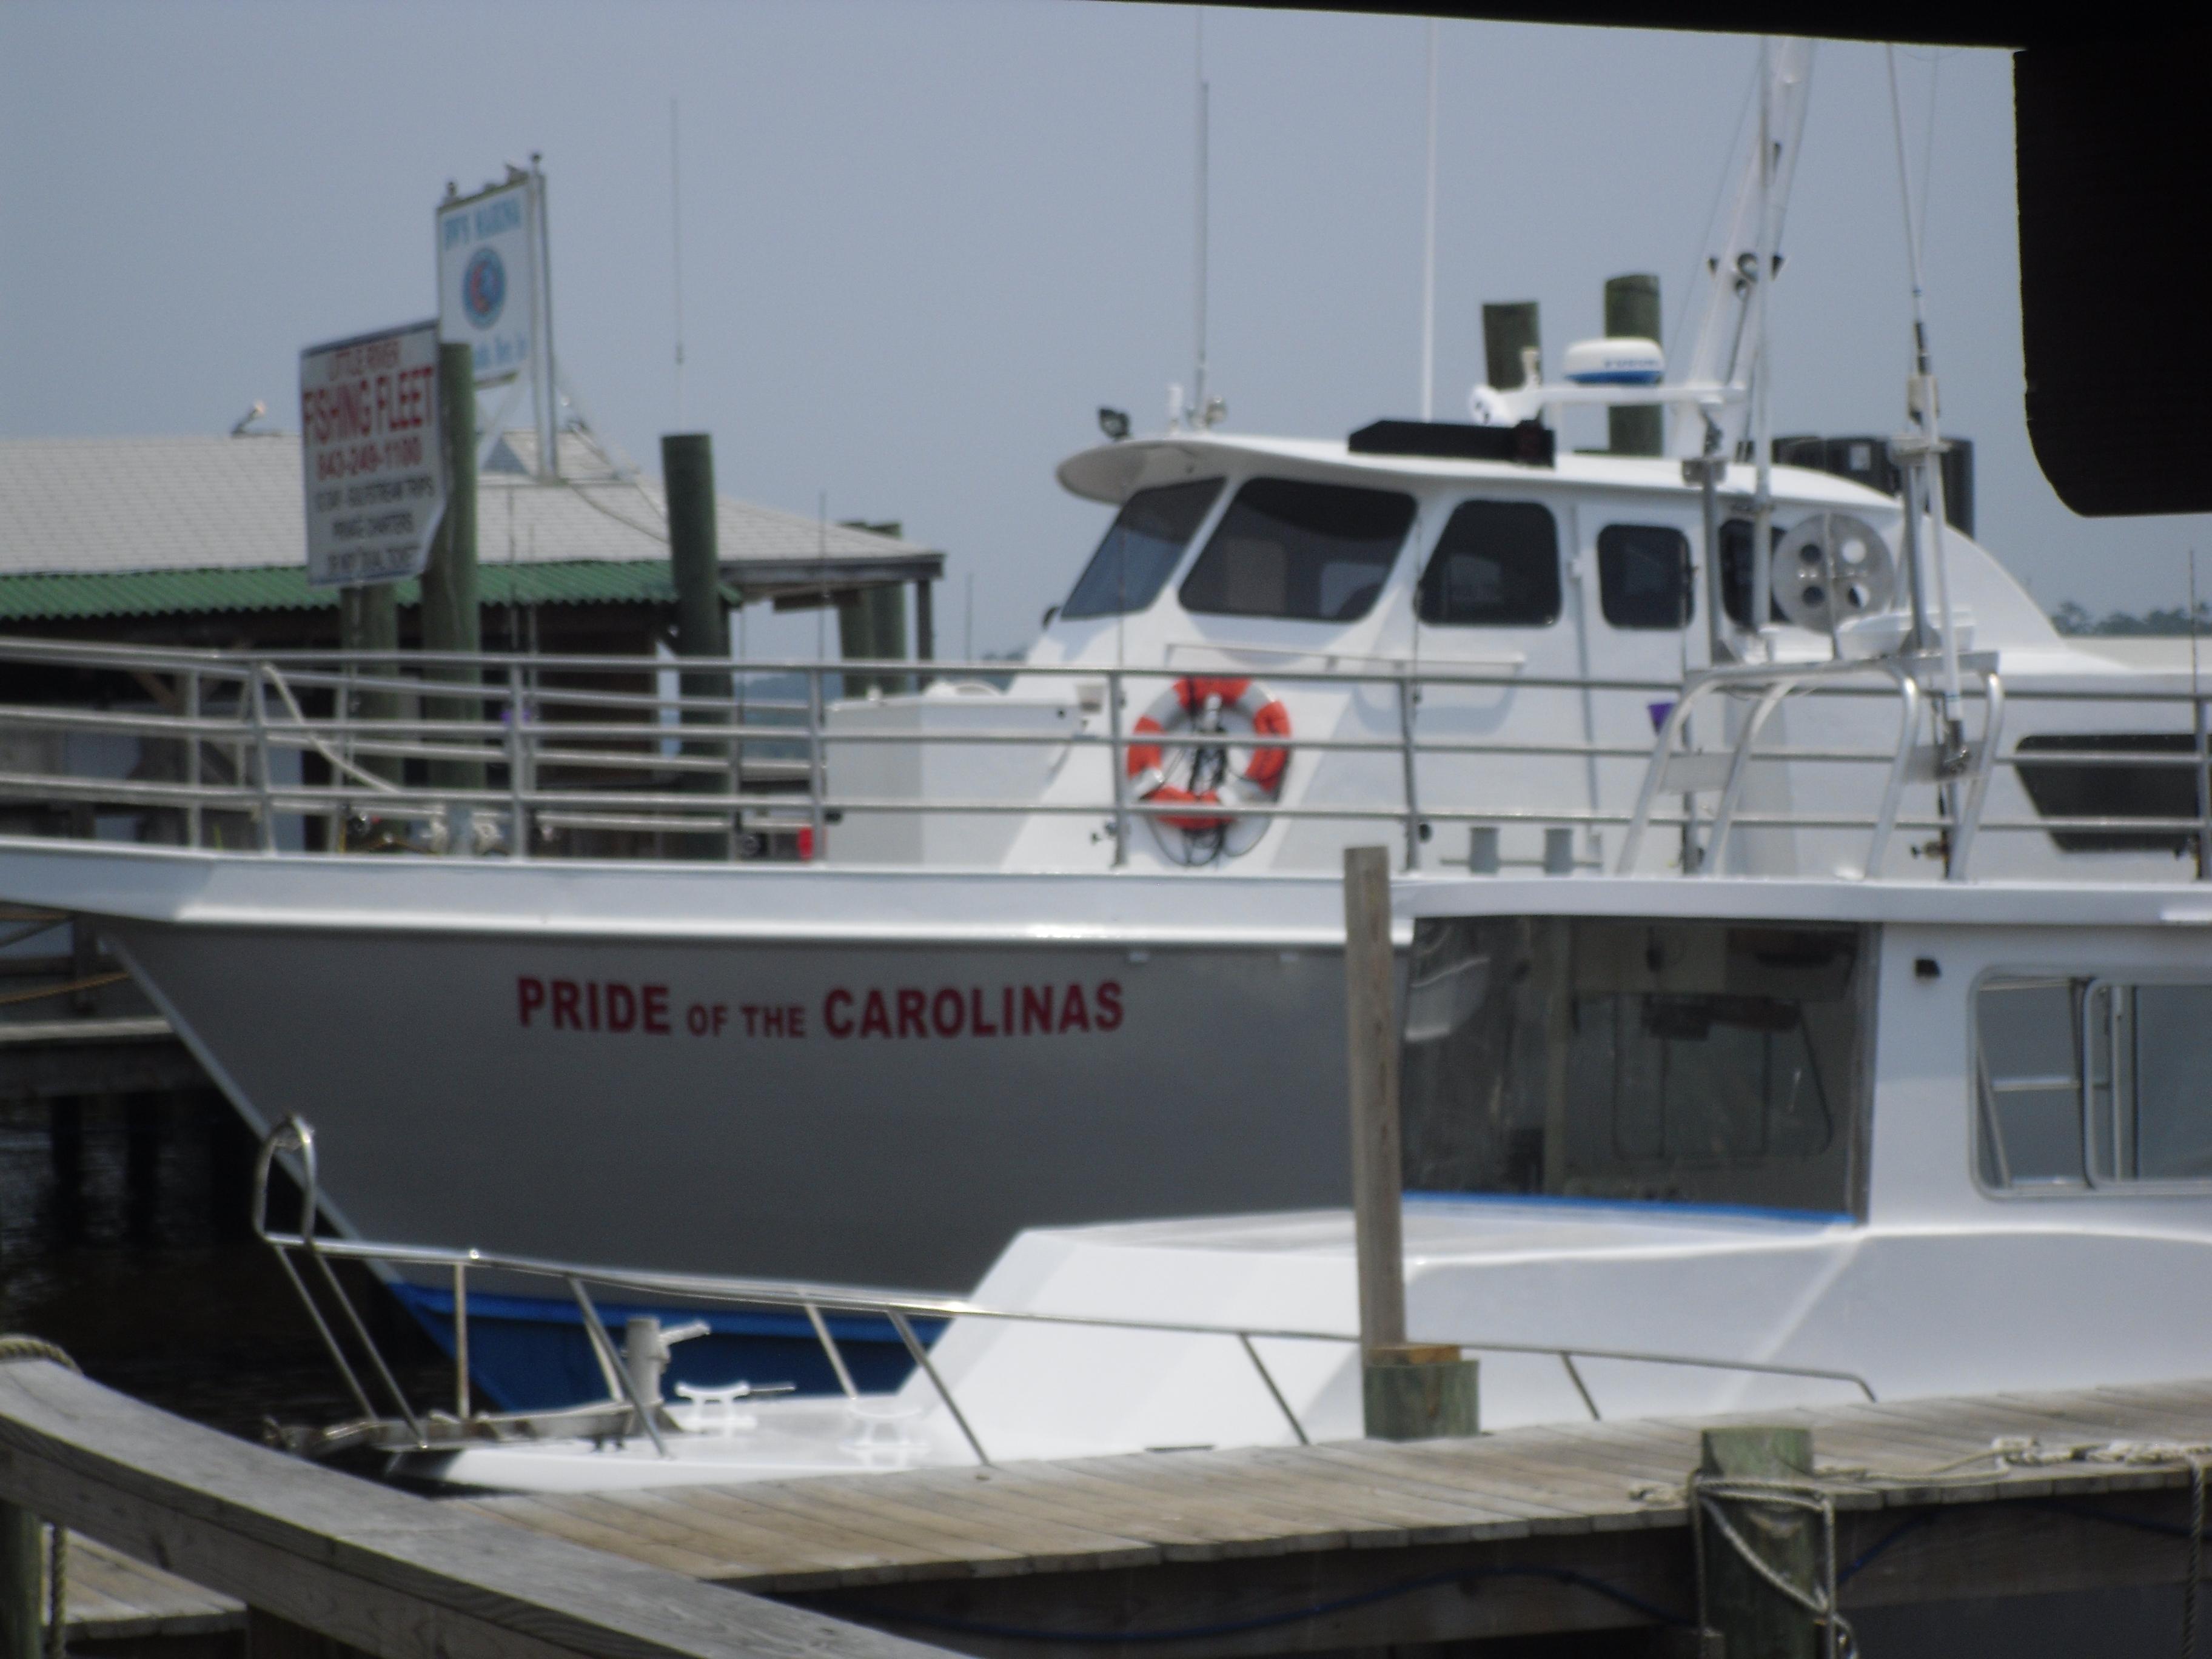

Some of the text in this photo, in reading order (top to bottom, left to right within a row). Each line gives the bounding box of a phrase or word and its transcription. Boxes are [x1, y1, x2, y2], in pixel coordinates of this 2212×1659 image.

[304, 364, 435, 447] FISHING FLEET
[518, 978, 1124, 1039] PRIDE OF THE CAROLINAS
